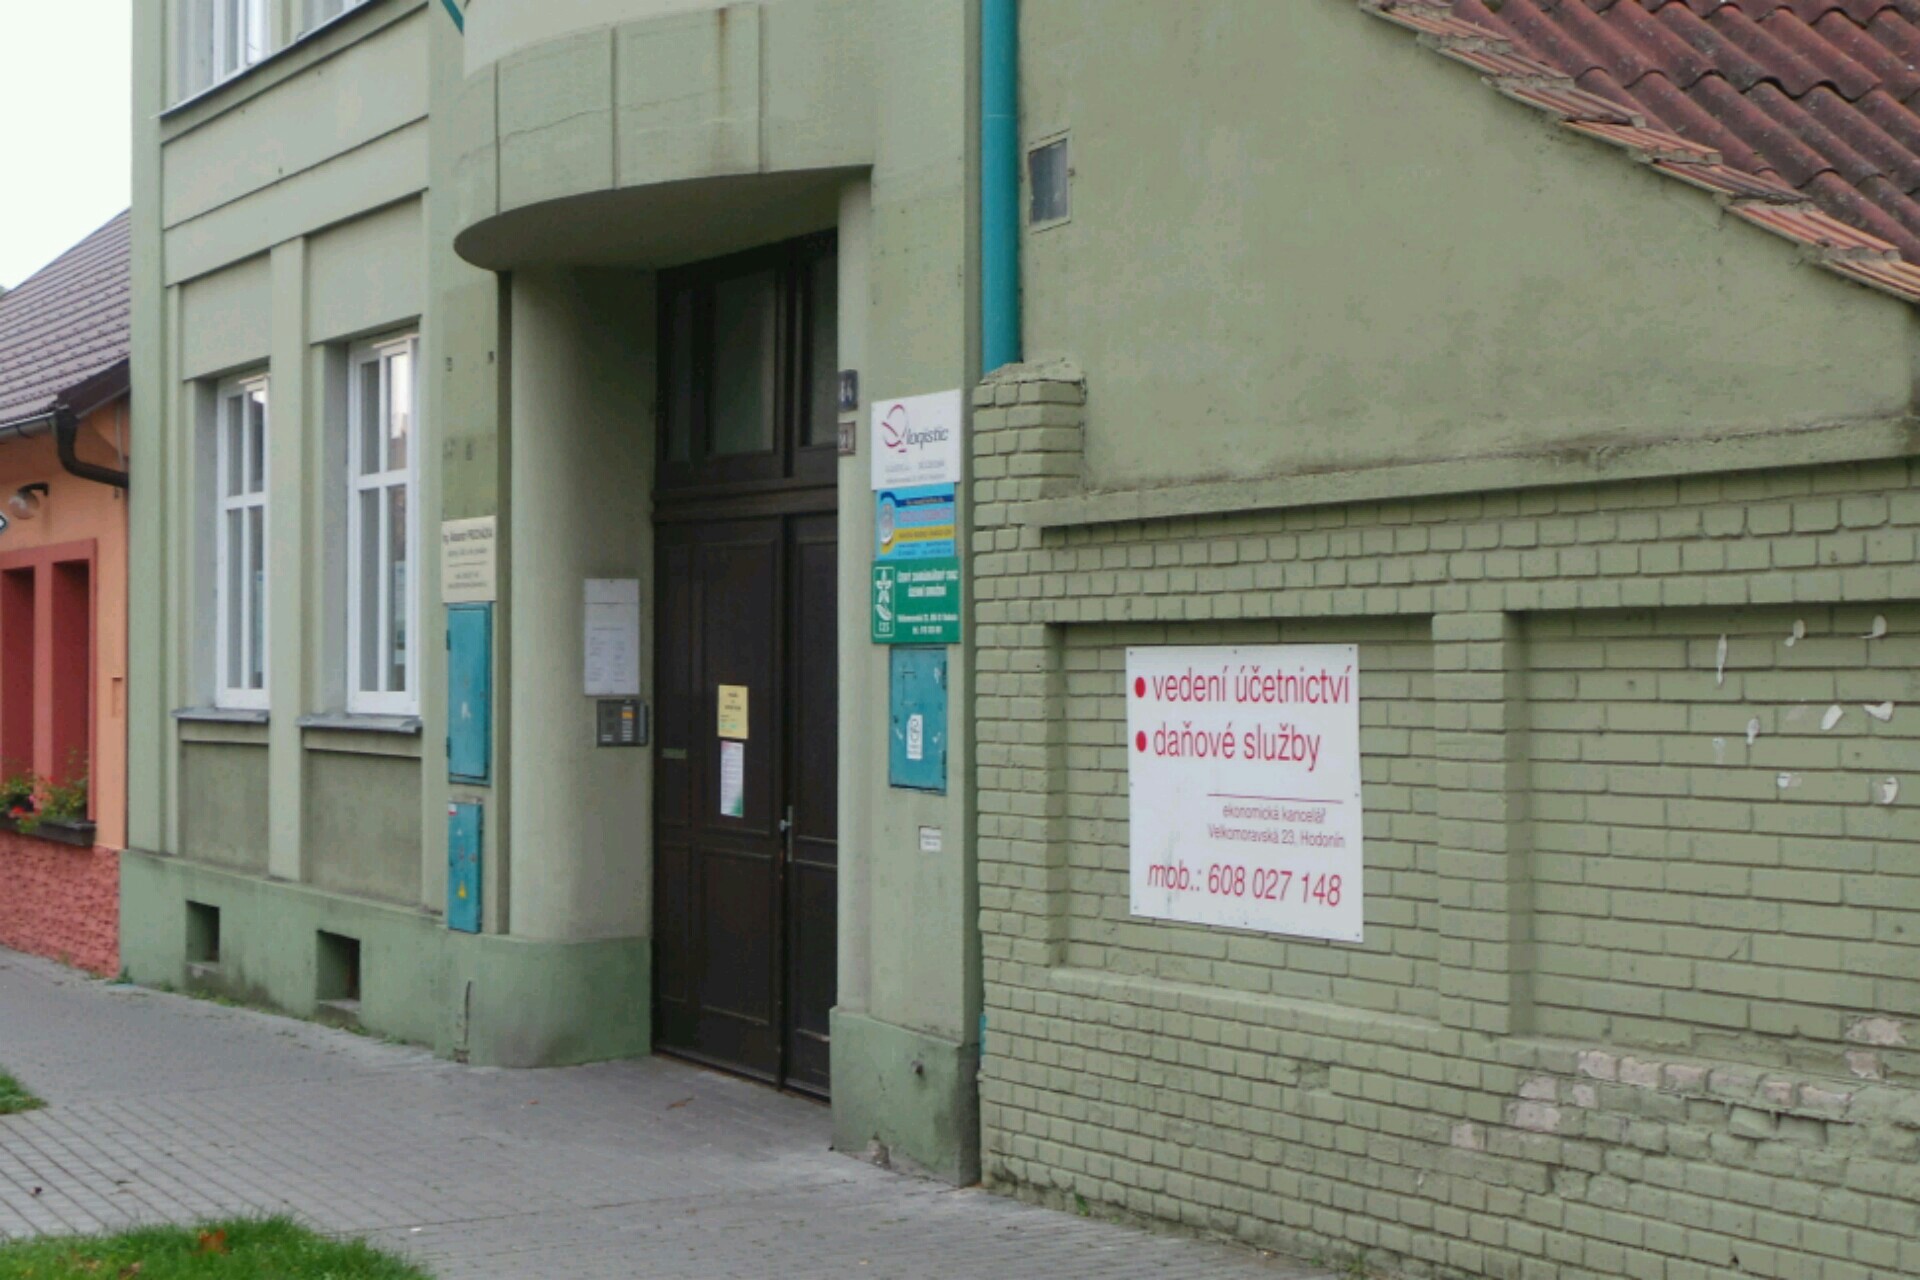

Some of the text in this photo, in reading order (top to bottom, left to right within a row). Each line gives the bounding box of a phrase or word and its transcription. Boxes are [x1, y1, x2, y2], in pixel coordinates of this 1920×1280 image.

[1153, 665, 1352, 704] vedení účetnictví
[1153, 721, 1321, 772] daňové služby
[1222, 803, 1327, 824] ekonomická kancelář
[1207, 823, 1279, 844] Velkomoravská
[1301, 831, 1346, 848] Hodonín
[1147, 859, 1342, 907] mob.: 608 027 148
